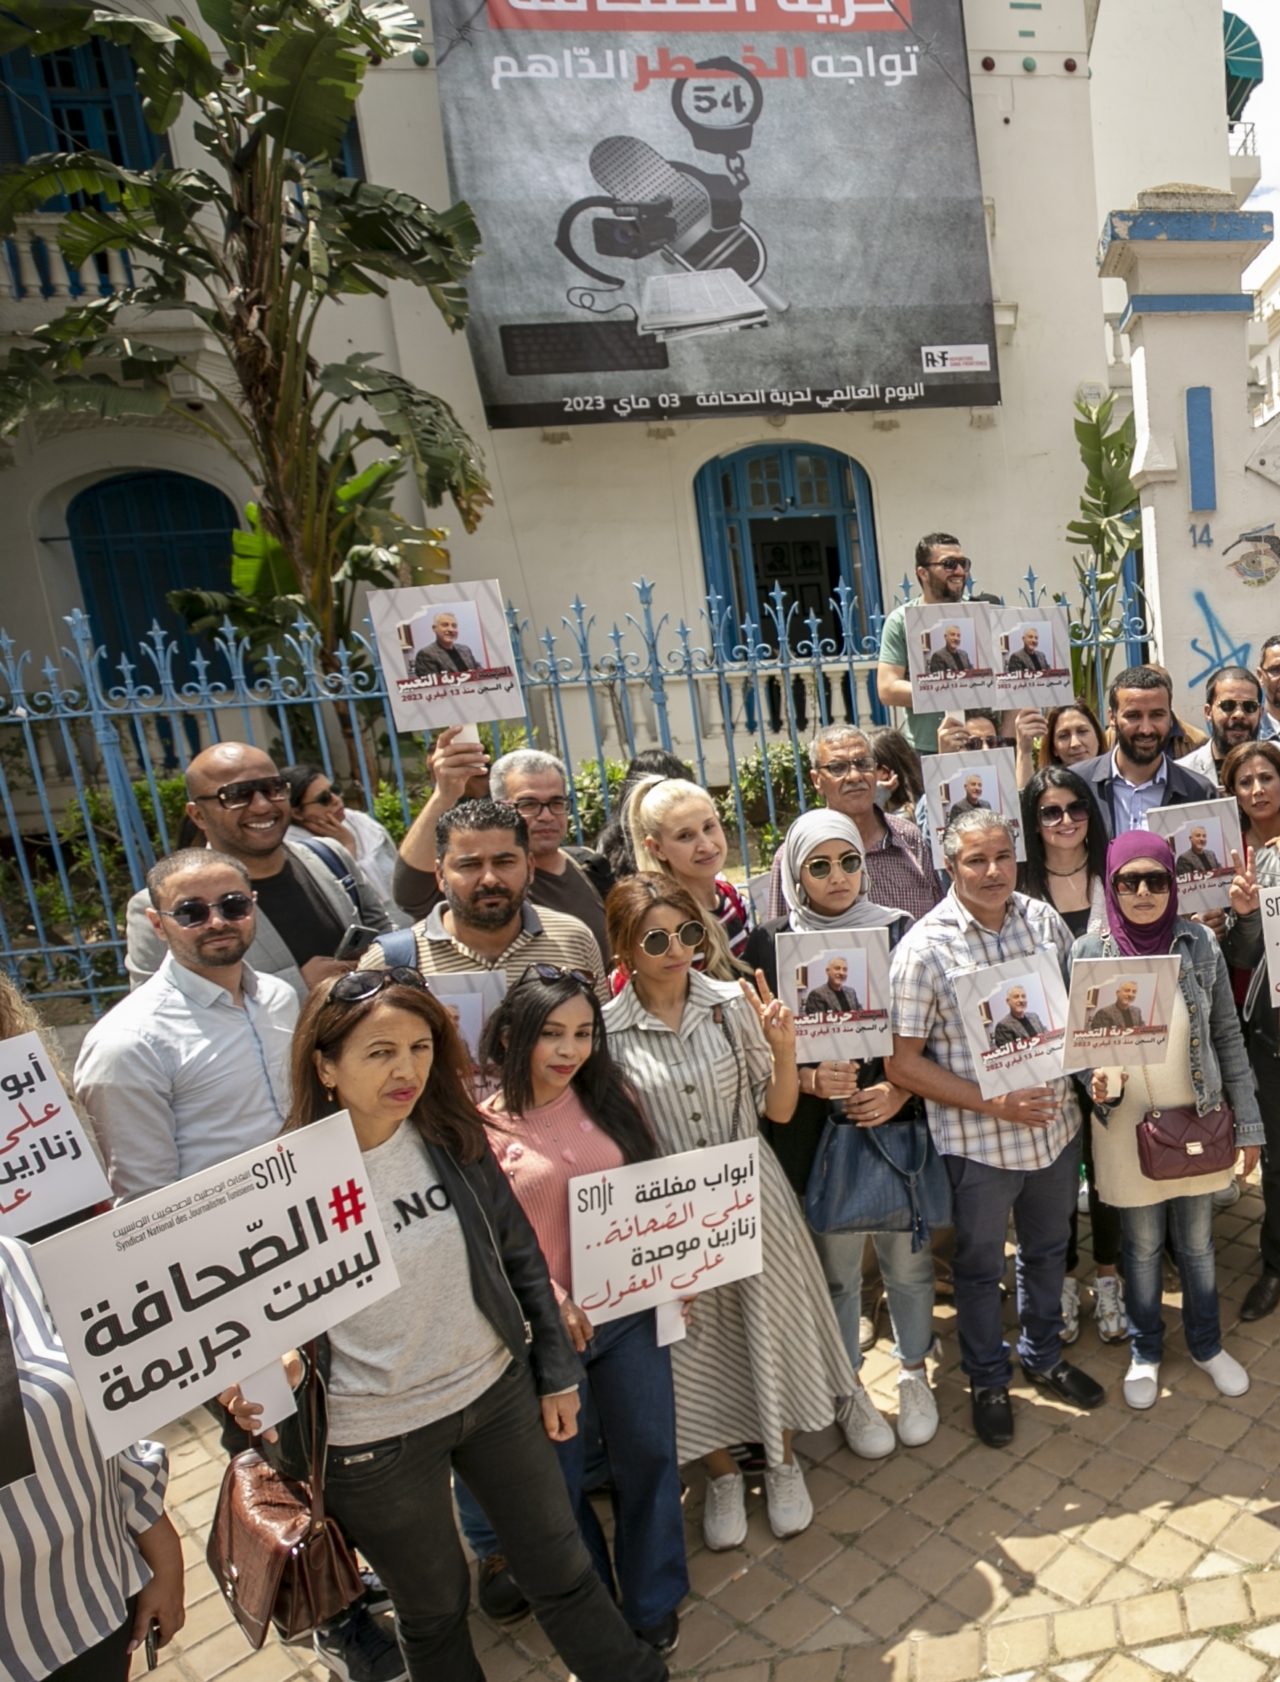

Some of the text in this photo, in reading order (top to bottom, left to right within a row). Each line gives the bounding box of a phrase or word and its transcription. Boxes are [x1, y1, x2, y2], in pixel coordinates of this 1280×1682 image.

[634, 45, 808, 92] الخطر
[811, 46, 919, 86] تواجه
[693, 85, 748, 113] 54
[563, 382, 925, 417] اليوم العالمي لحرية الصحافة 03 ماي 2023
[1189, 523, 1214, 548] 14
[398, 673, 438, 693] التعبير
[441, 669, 472, 687] حرية
[477, 683, 502, 694] السجن
[504, 683, 514, 693] في
[401, 694, 423, 702] 2023
[794, 1012, 823, 1026] التعبي
[826, 1010, 853, 1024] حرية
[1016, 1034, 1041, 1050] حرية
[0, 1052, 47, 1100] أبو
[252, 1144, 298, 1190] snjt
[635, 1153, 755, 1204] أبواب مغلقة
[577, 1175, 615, 1216] snjt
[631, 1217, 756, 1267] زنازين موصدة
[580, 1264, 662, 1311] العقول
[99, 1230, 381, 1412] ليست جريمة
